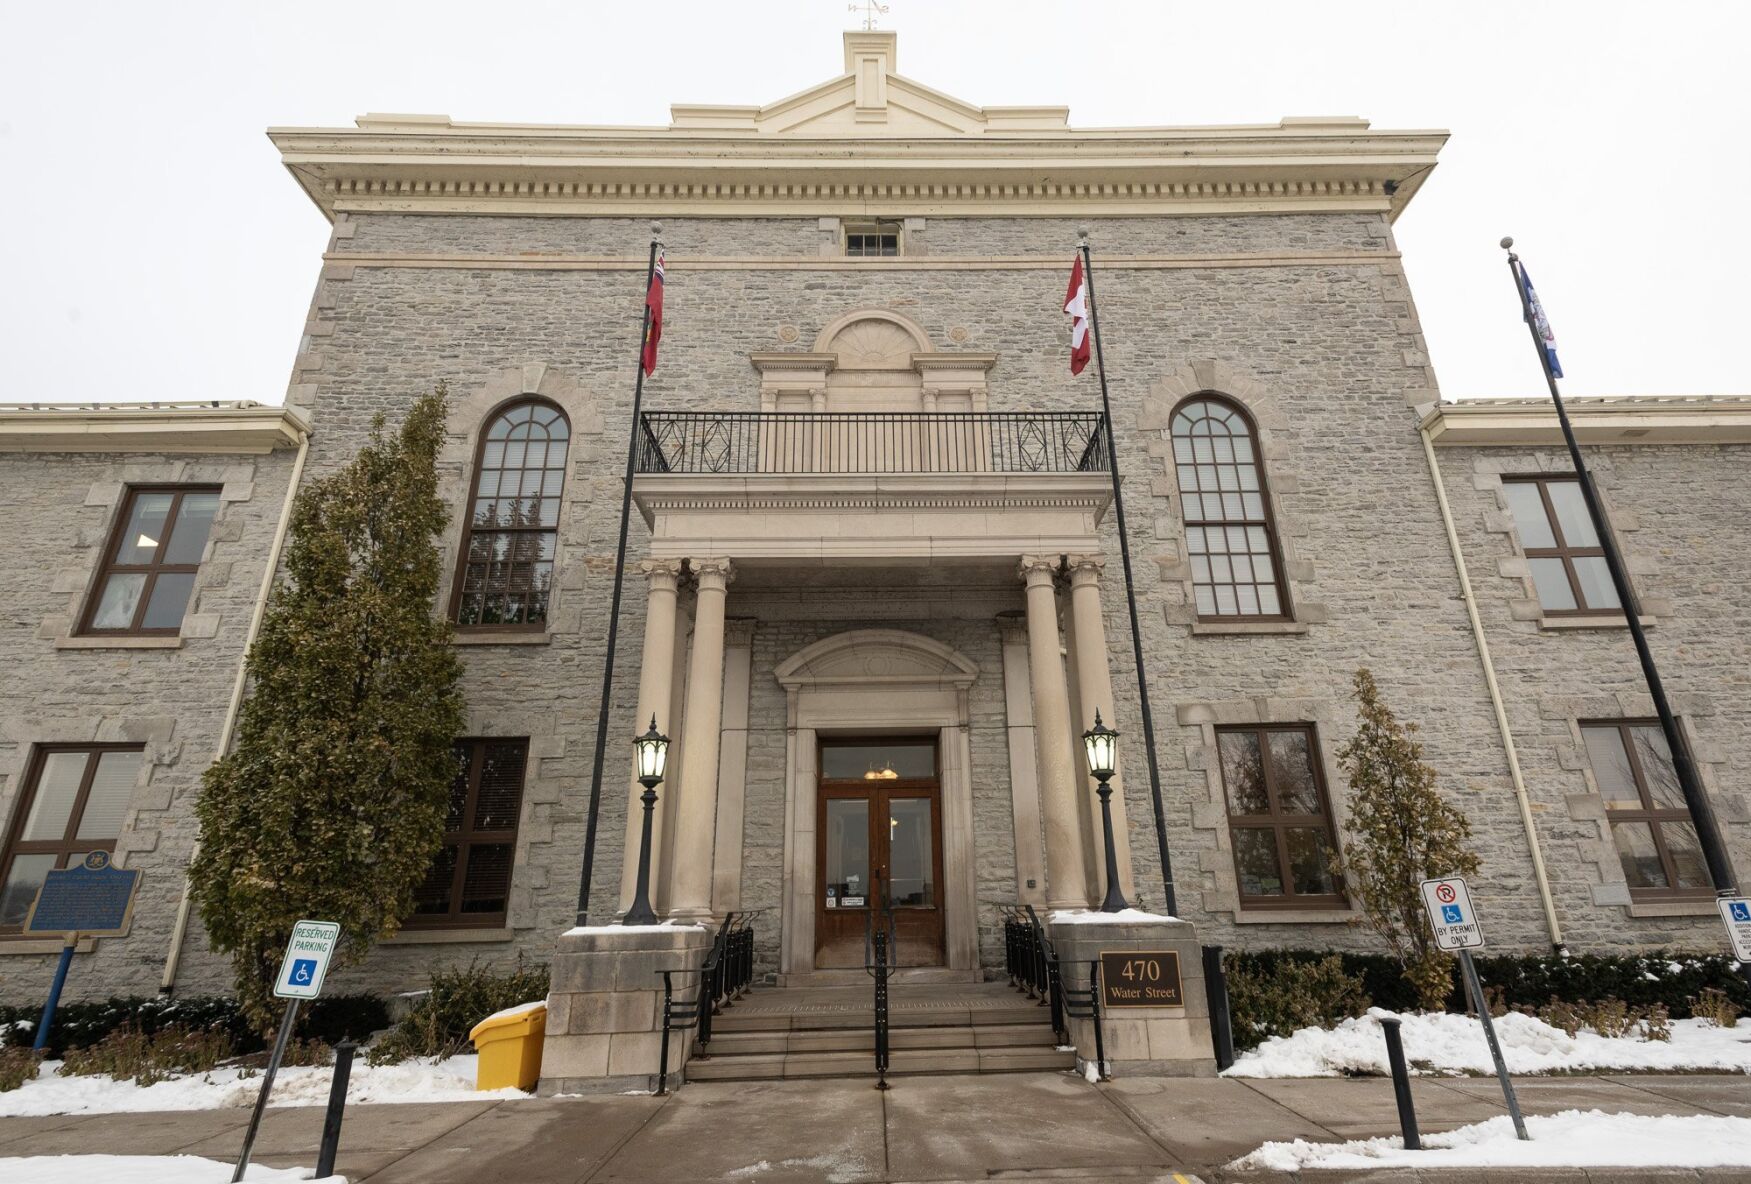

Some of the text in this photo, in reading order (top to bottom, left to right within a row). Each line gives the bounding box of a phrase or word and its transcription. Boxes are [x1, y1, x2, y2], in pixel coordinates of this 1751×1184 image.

[295, 927, 335, 940] RESERVED
[1437, 924, 1475, 936] BY PERMIT
[1450, 935, 1469, 945] ONLY
[294, 940, 329, 953] PARKING
[1121, 960, 1160, 981] 470
[1111, 986, 1176, 998] Water Street
